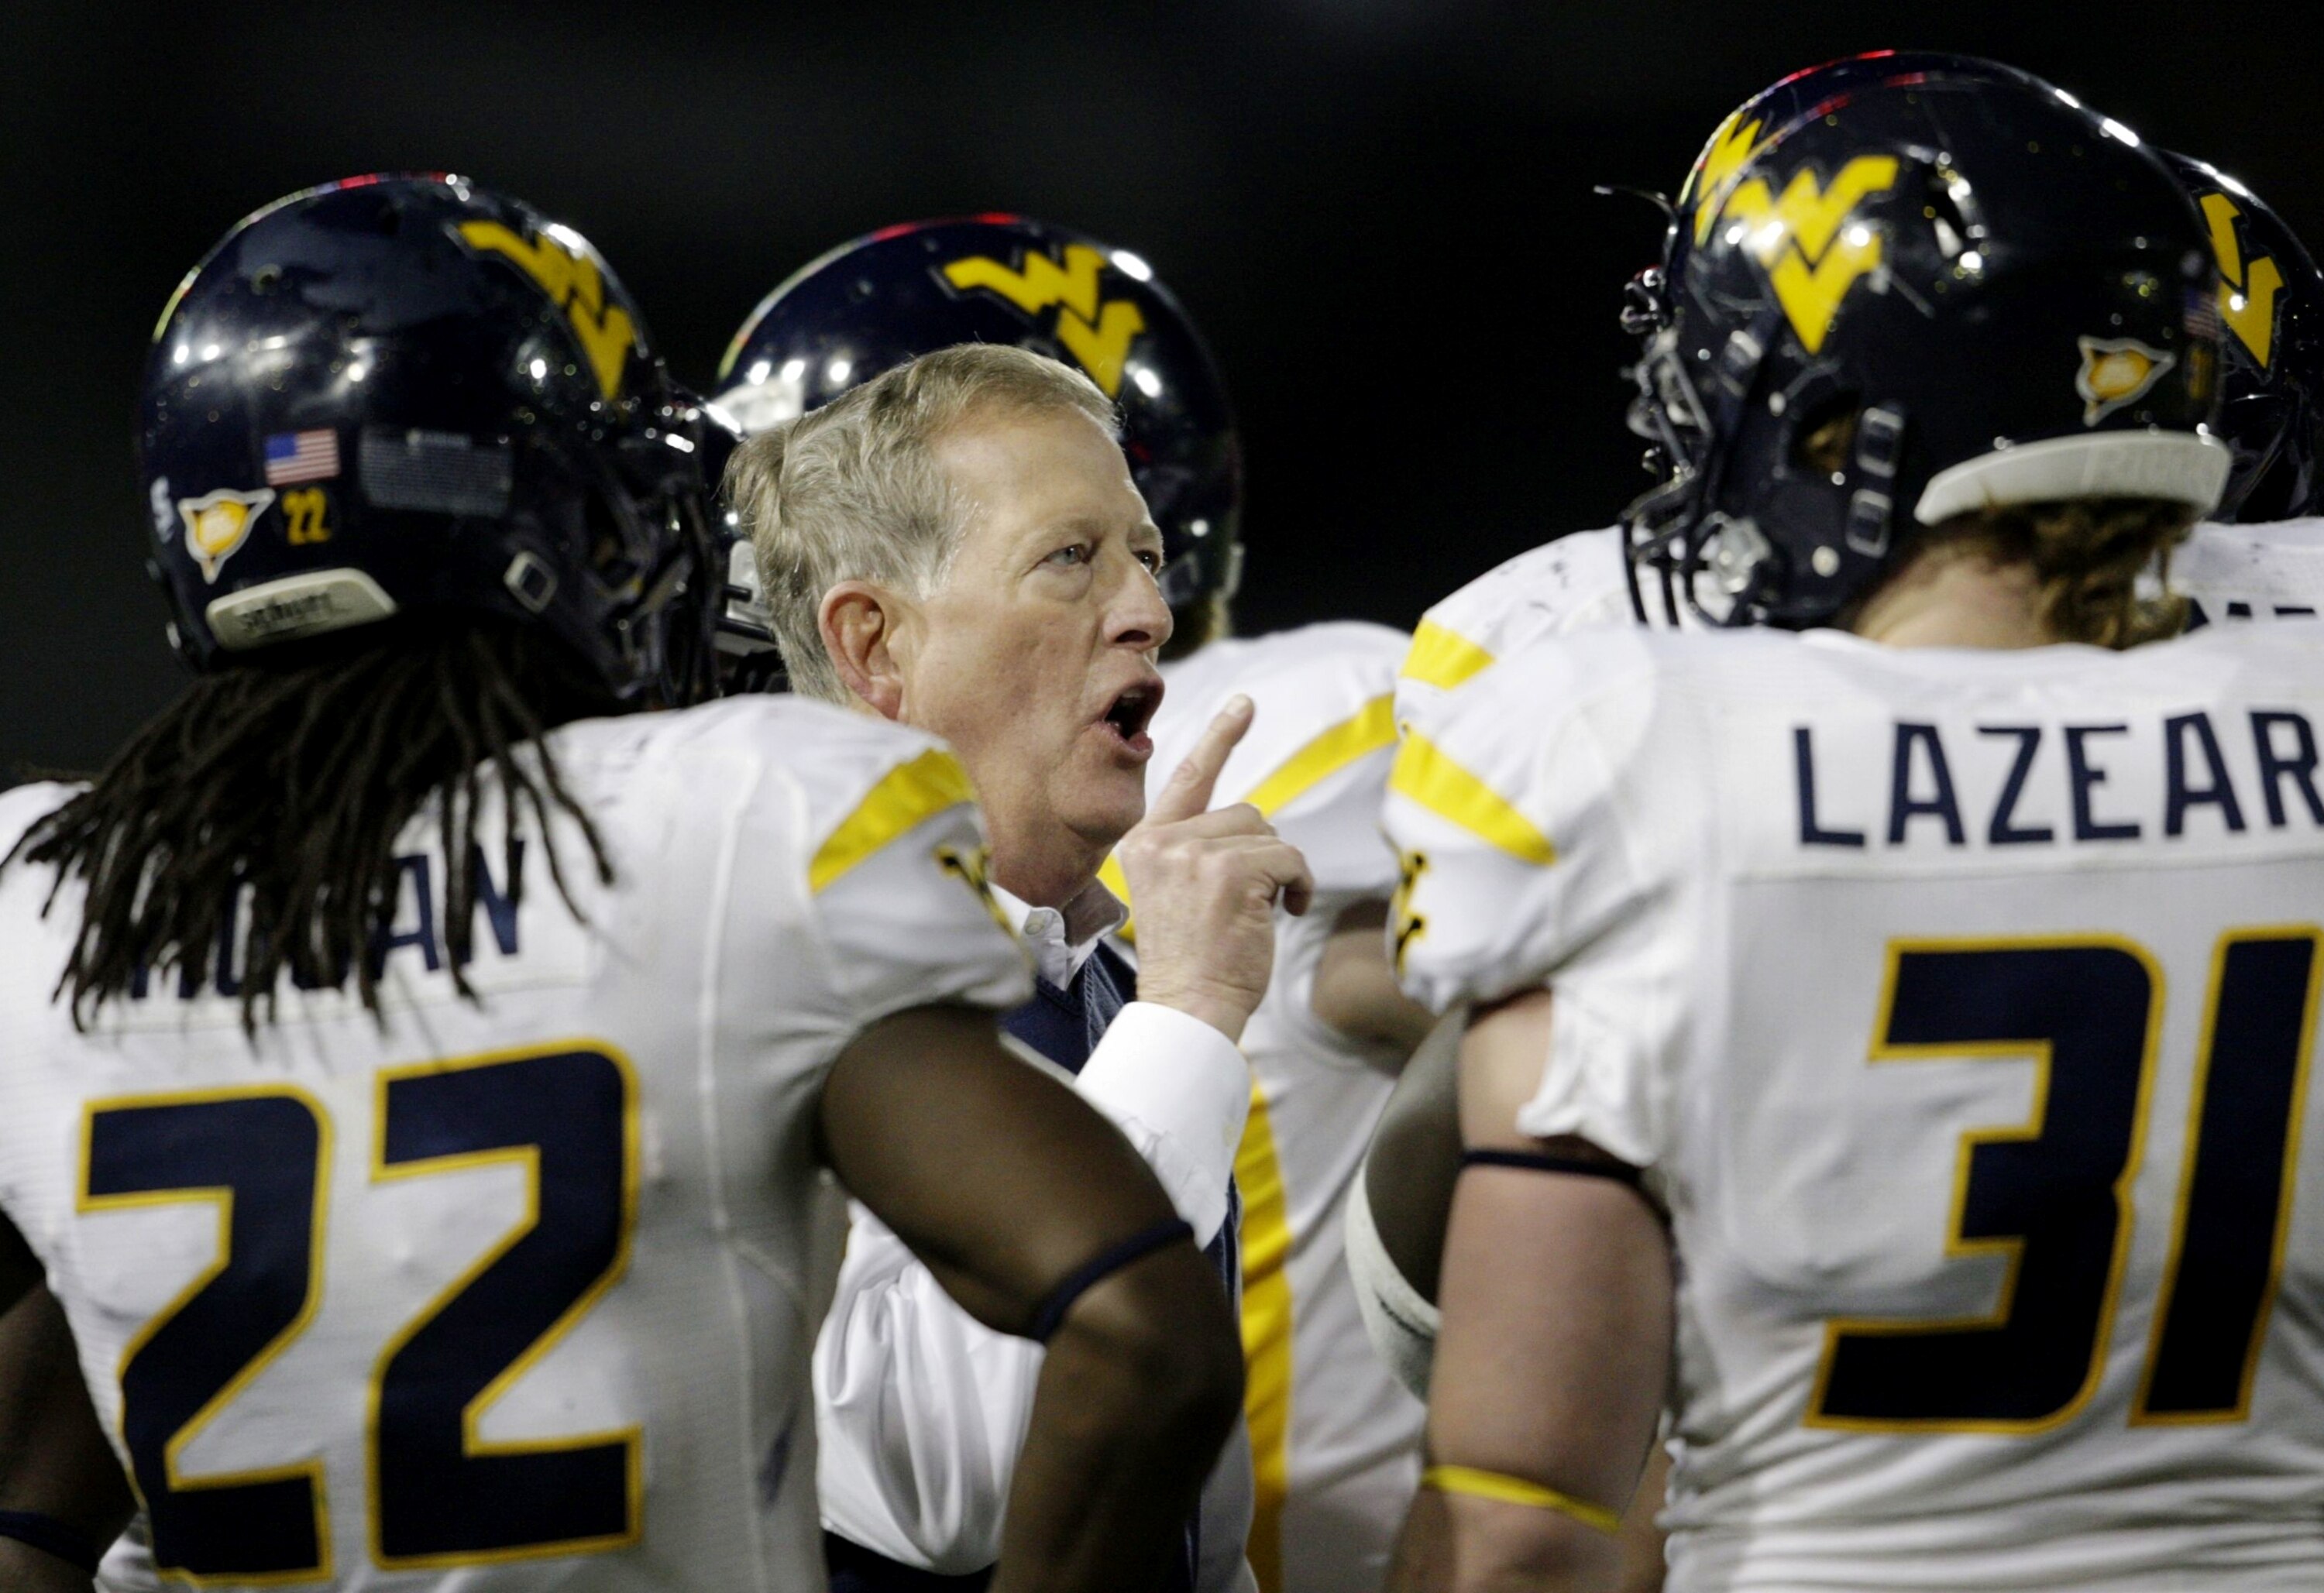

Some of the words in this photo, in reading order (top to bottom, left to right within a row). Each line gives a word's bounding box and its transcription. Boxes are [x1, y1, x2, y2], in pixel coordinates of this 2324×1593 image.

[942, 242, 1147, 398] WV
[281, 486, 332, 547] 22
[1792, 708, 2324, 847] LAZEAR
[1800, 922, 2324, 1437] 31
[75, 1036, 645, 1589] 22
